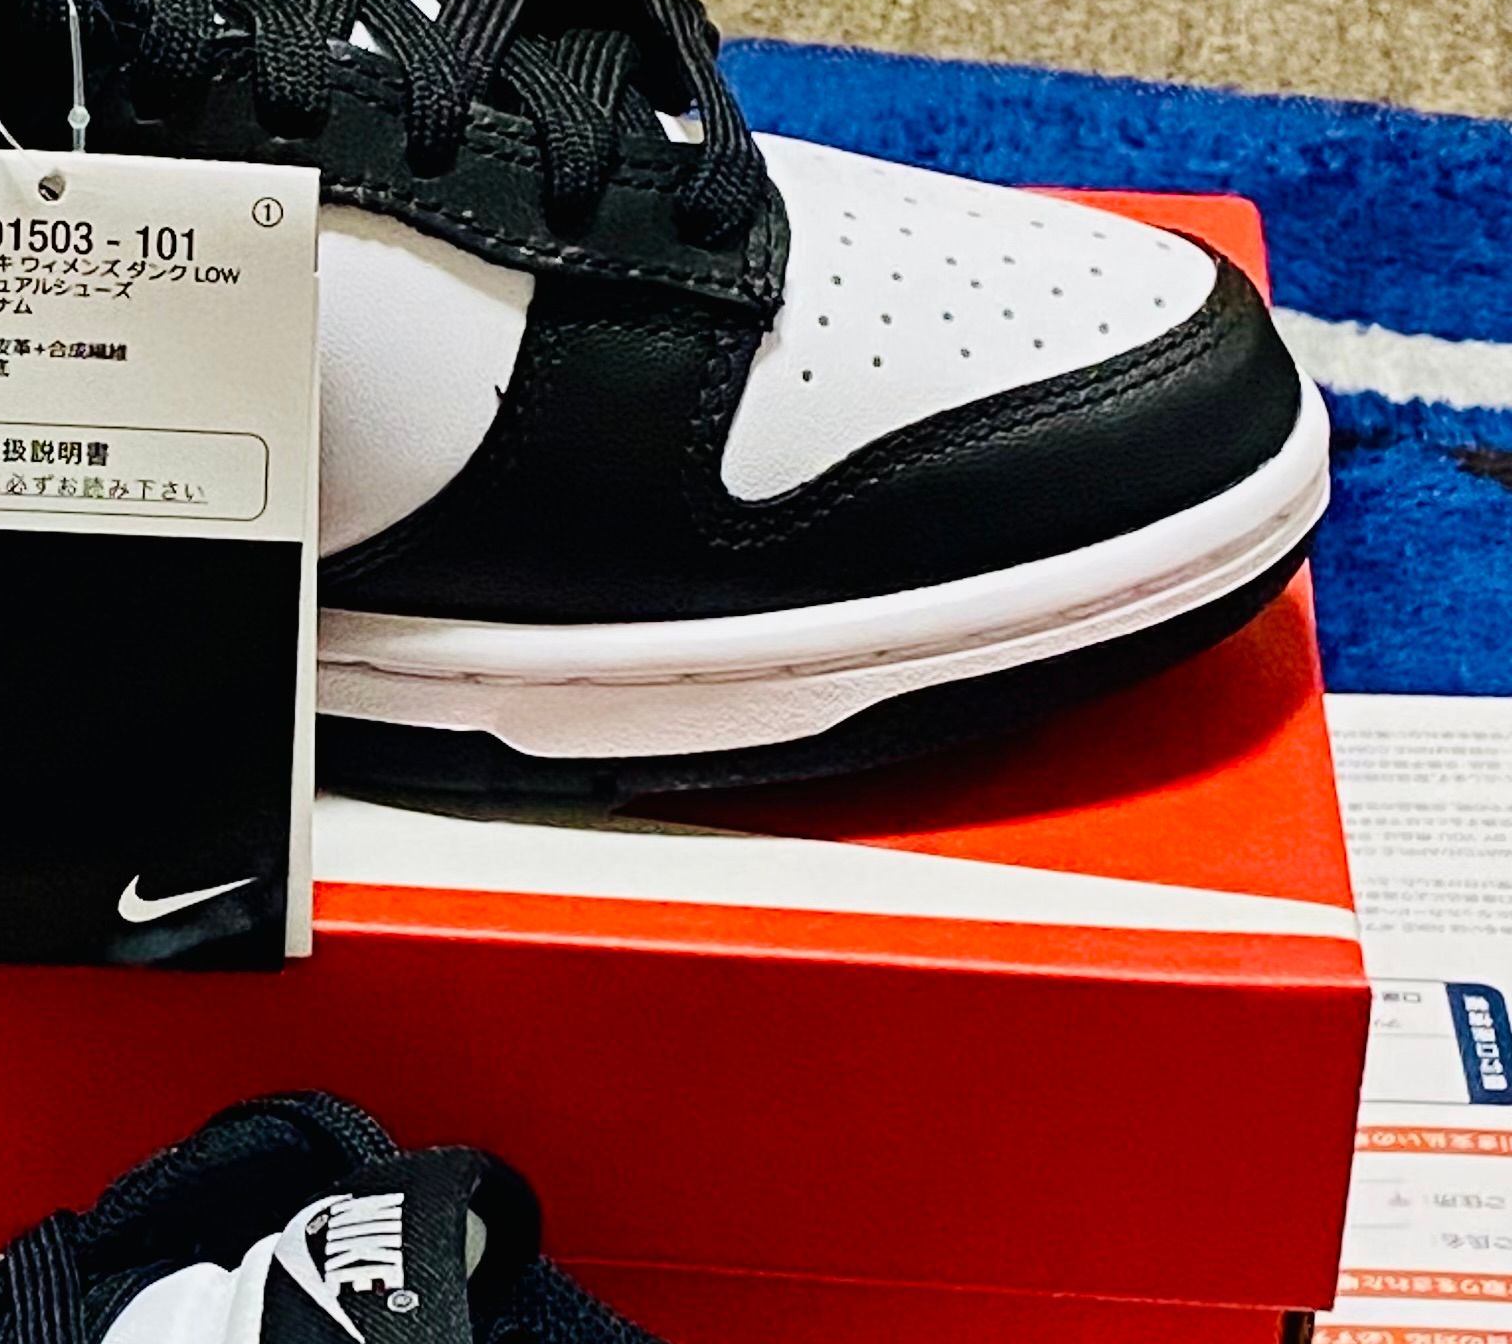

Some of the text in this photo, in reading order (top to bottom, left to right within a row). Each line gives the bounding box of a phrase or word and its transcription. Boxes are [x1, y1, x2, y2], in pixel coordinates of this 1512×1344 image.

[136, 226, 194, 261] 101
[126, 260, 187, 281] ダンク
[194, 265, 240, 284] LOW
[324, 1192, 405, 1294] NIKE
